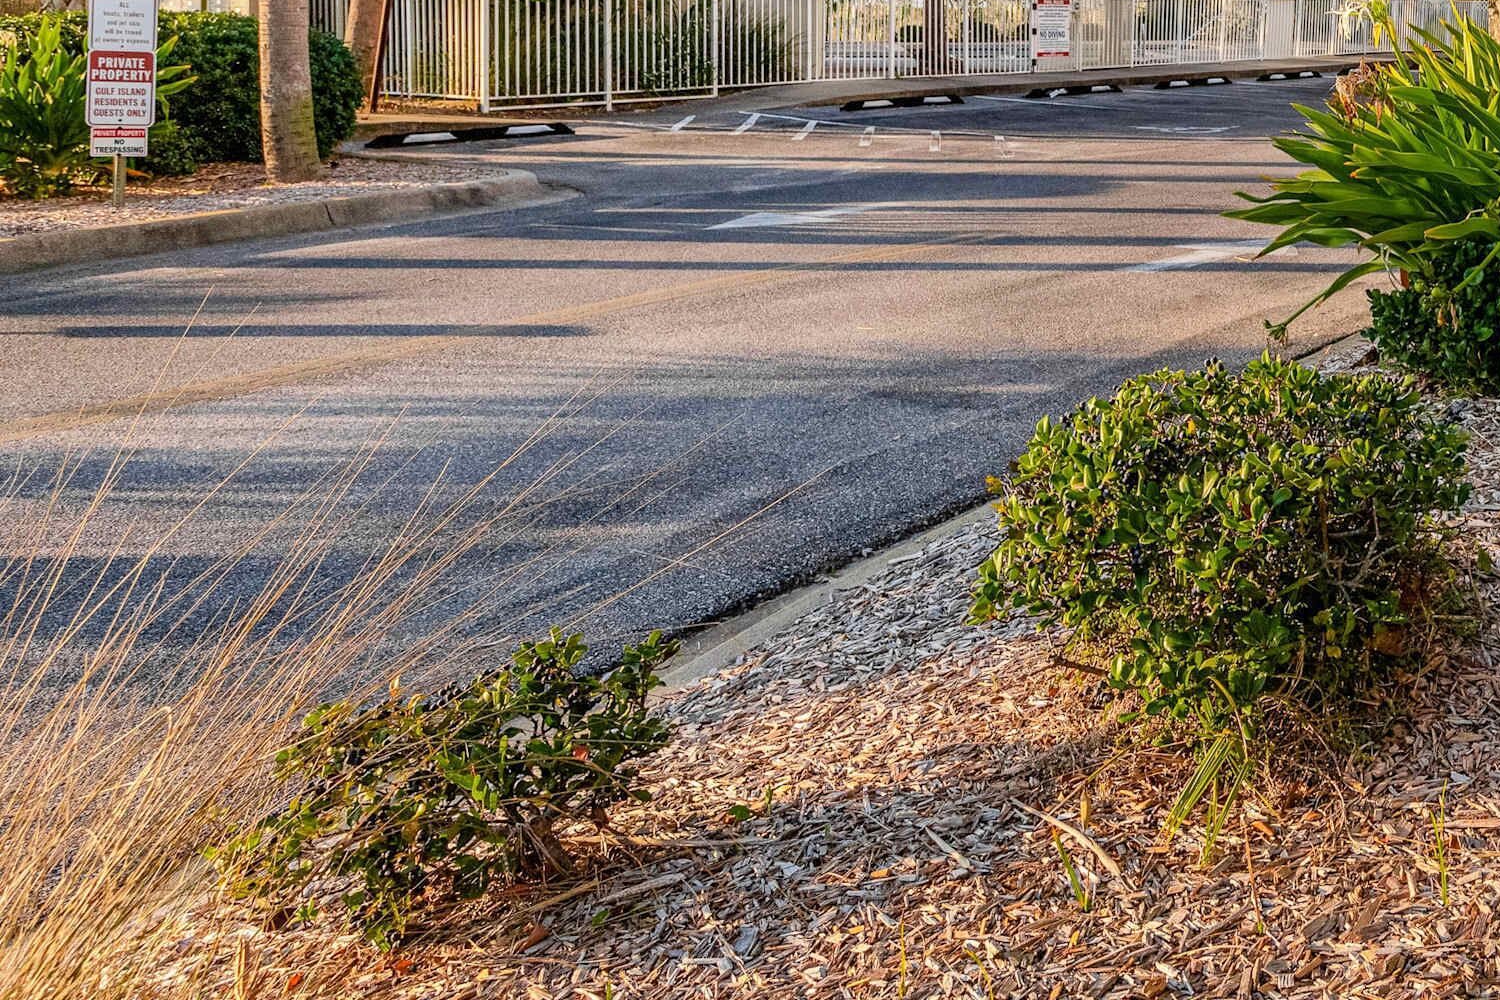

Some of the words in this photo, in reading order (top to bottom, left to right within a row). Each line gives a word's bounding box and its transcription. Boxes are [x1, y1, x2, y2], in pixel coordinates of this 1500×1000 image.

[98, 56, 146, 69] PRIVATE
[91, 68, 152, 81] PROPERTY
[118, 88, 146, 96] ISLAND
[95, 98, 138, 106] RESIDENTS
[94, 109, 124, 117] GUESTS
[126, 109, 146, 117] ONLY
